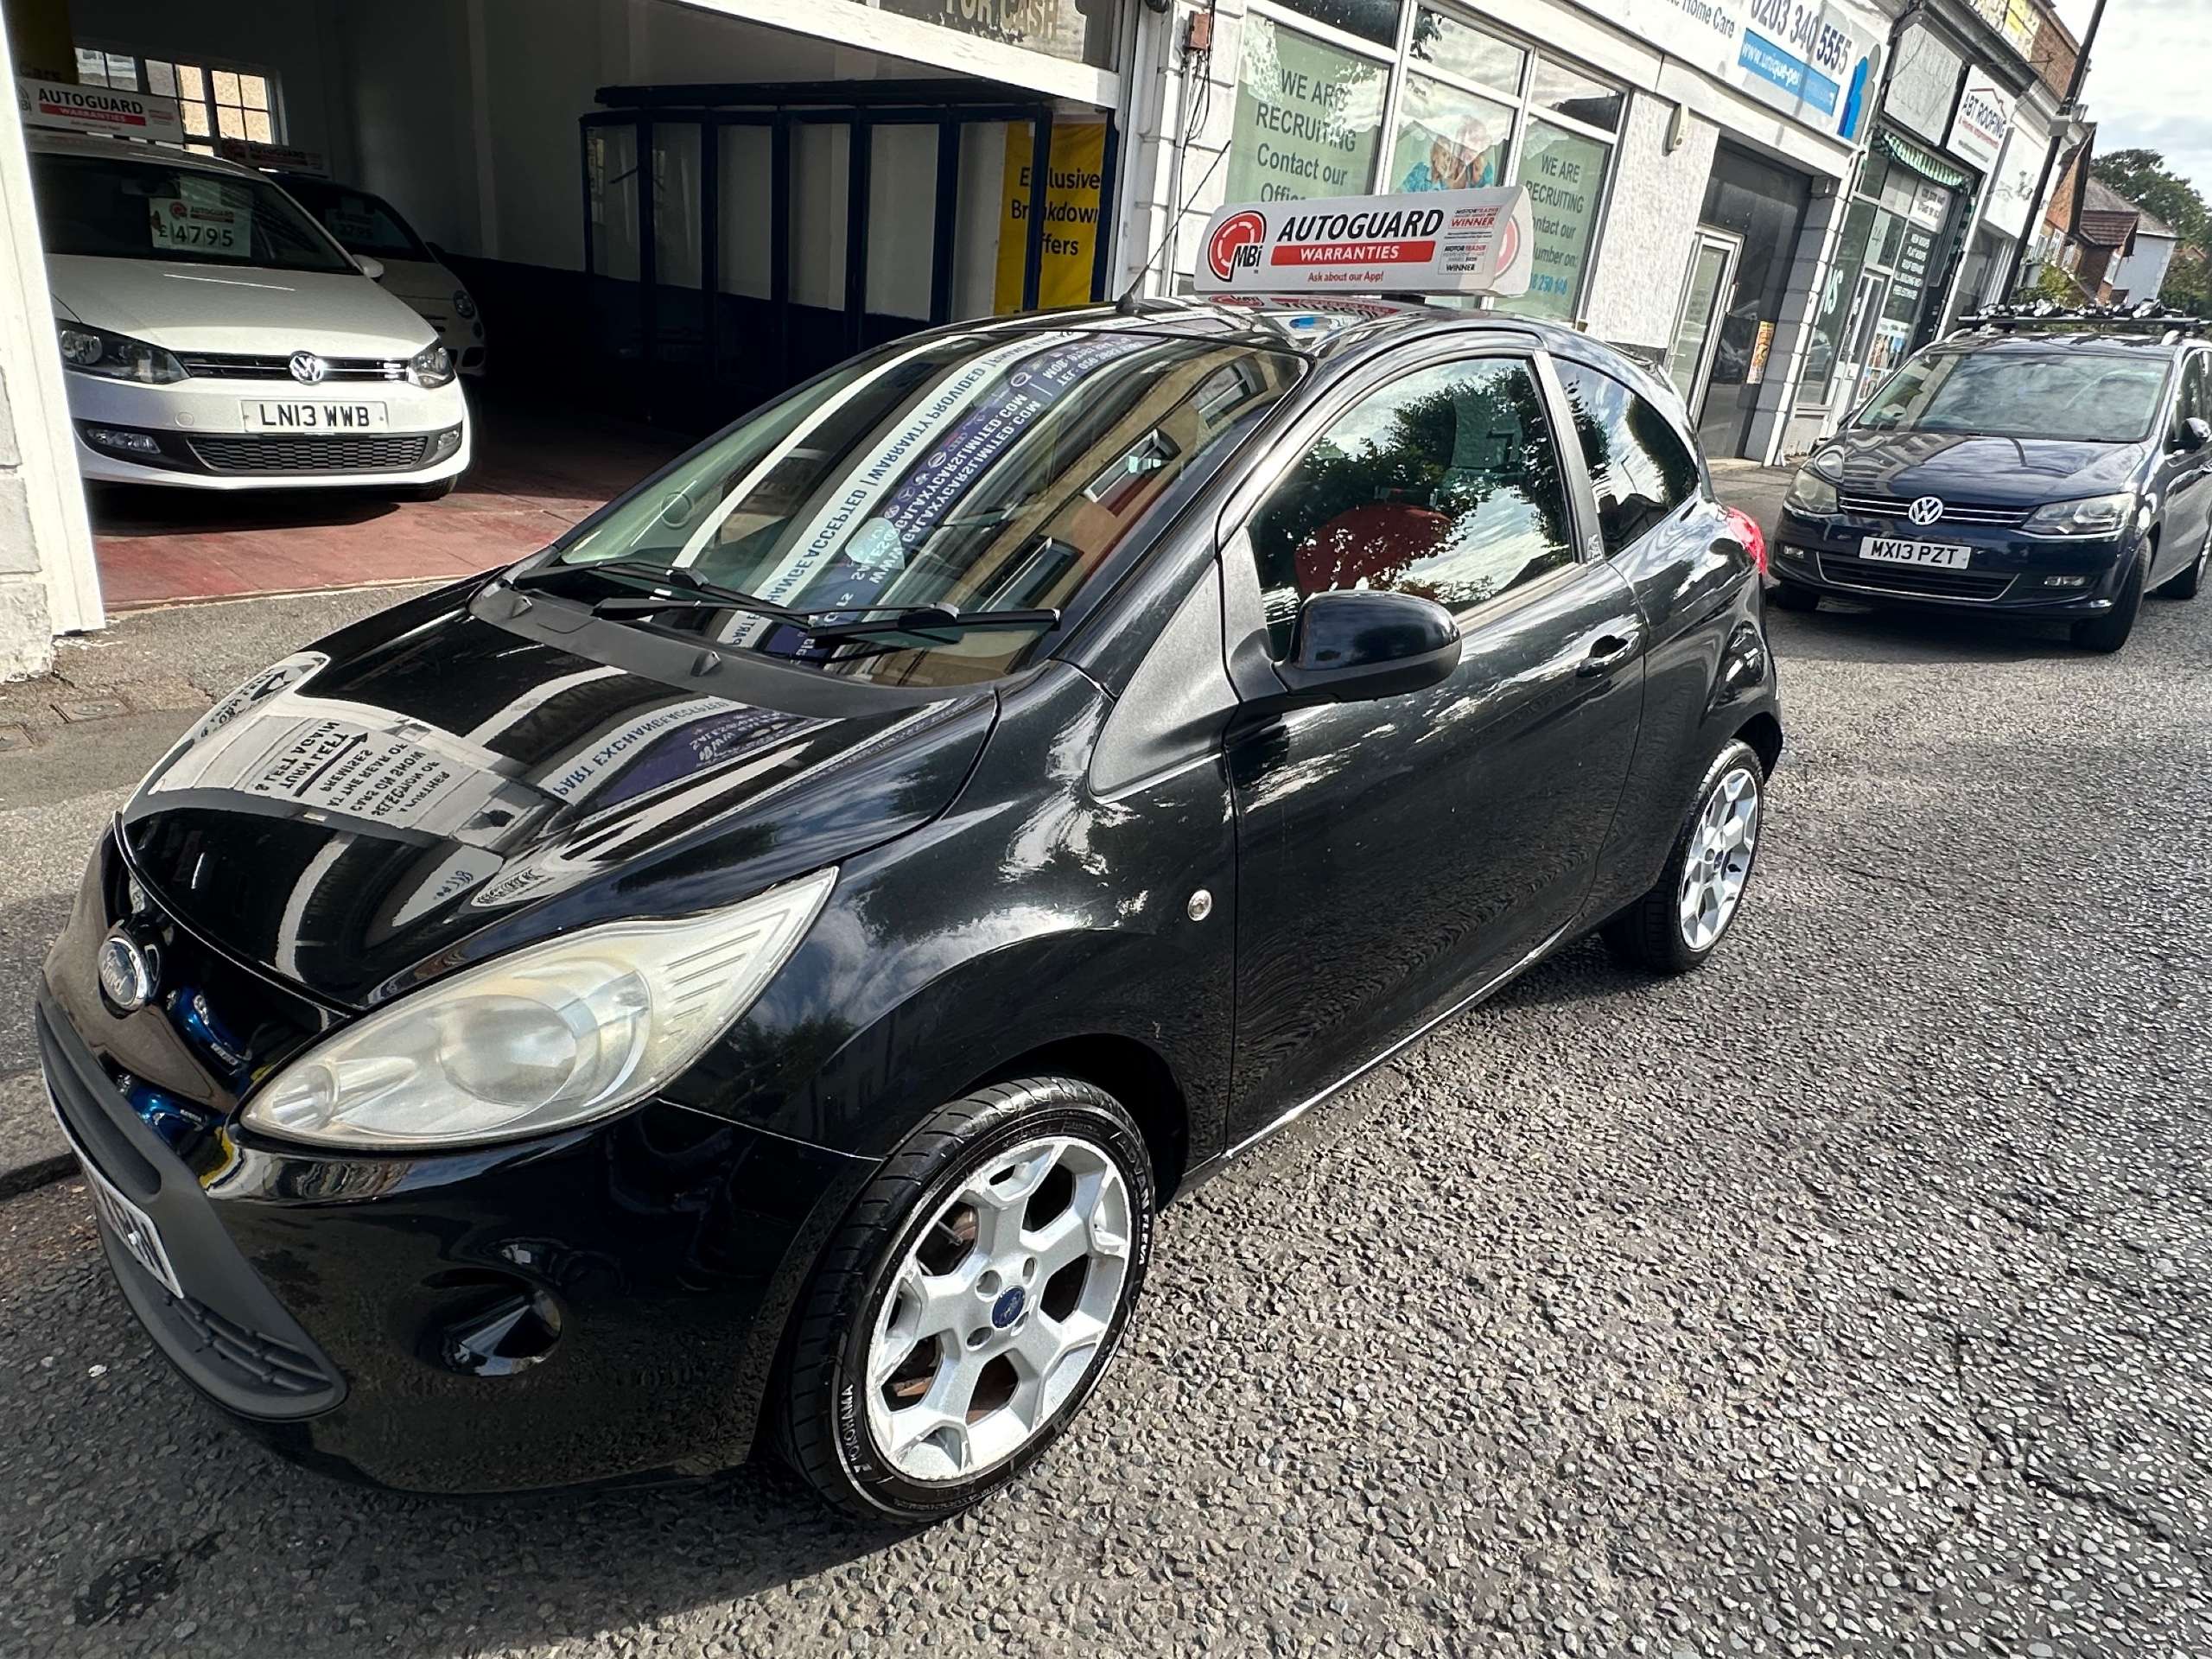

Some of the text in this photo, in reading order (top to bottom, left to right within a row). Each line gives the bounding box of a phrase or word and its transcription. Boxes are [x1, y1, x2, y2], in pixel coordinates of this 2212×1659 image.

[1713, 6, 1736, 39] Care
[1790, 4, 1817, 55] 340
[1816, 23, 1853, 76] 5555
[1281, 68, 1308, 100] WE
[38, 87, 144, 115] AUTOGUARD
[1020, 166, 1101, 190] Elusive
[1257, 143, 1348, 186] Contact our
[1541, 154, 1581, 184] WE ARE
[1011, 198, 1098, 224] Brkdow
[1452, 217, 1495, 227] WINNER
[1276, 208, 1445, 243] AUTOGUARD
[1560, 224, 1577, 240] our
[1299, 245, 1401, 262] WARRANTIES
[1534, 241, 1564, 265] umber
[1307, 271, 1323, 282] Ask
[1325, 270, 1347, 282] about
[1446, 264, 1475, 272] WINNER
[259, 404, 370, 428] LN13 WWB
[1871, 540, 1959, 564] MX13 PZT
[102, 949, 128, 996] Ford
[1138, 1213, 1151, 1266] FLEVA
[841, 1384, 863, 1462] YOKOHAMA
